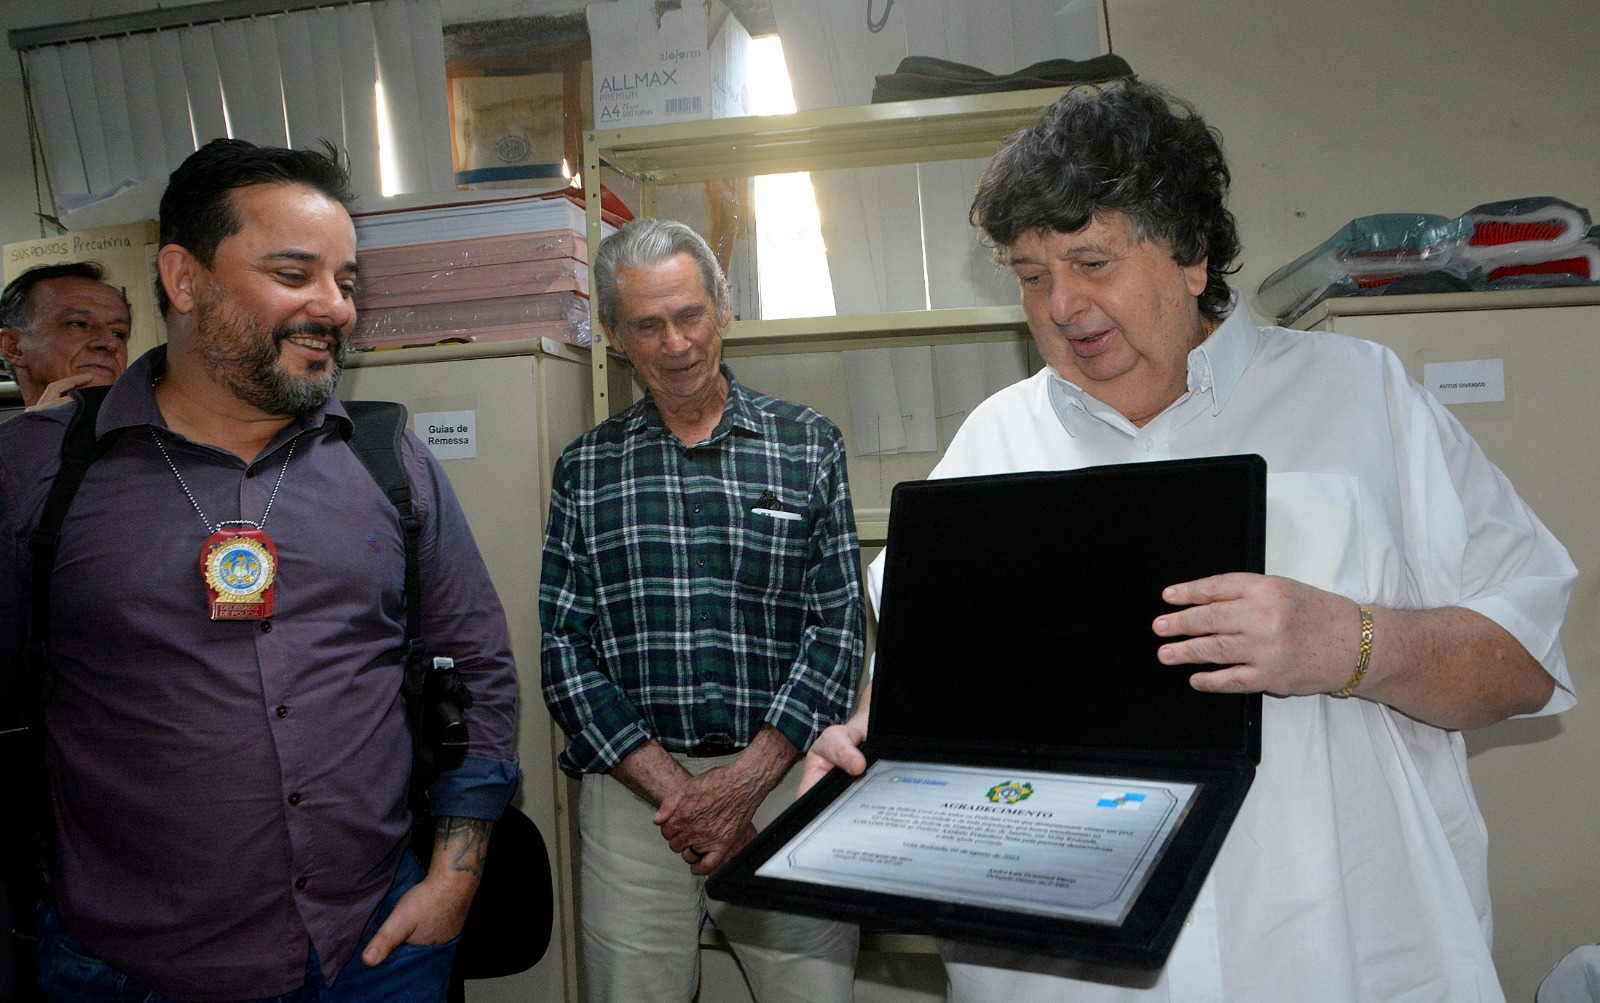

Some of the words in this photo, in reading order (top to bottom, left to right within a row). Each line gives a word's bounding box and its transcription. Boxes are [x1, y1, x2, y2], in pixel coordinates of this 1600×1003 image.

[659, 49, 702, 64] aloform
[599, 68, 678, 93] ALLMAX
[599, 91, 638, 101] PREMIUM
[600, 104, 620, 120] A4
[622, 110, 633, 118] 500
[11, 242, 68, 262] SUSPENSOS
[428, 424, 454, 434] Guias
[456, 424, 468, 433] de
[428, 436, 469, 445] Remessa
[940, 802, 1053, 818] AGRADECIMENTO
